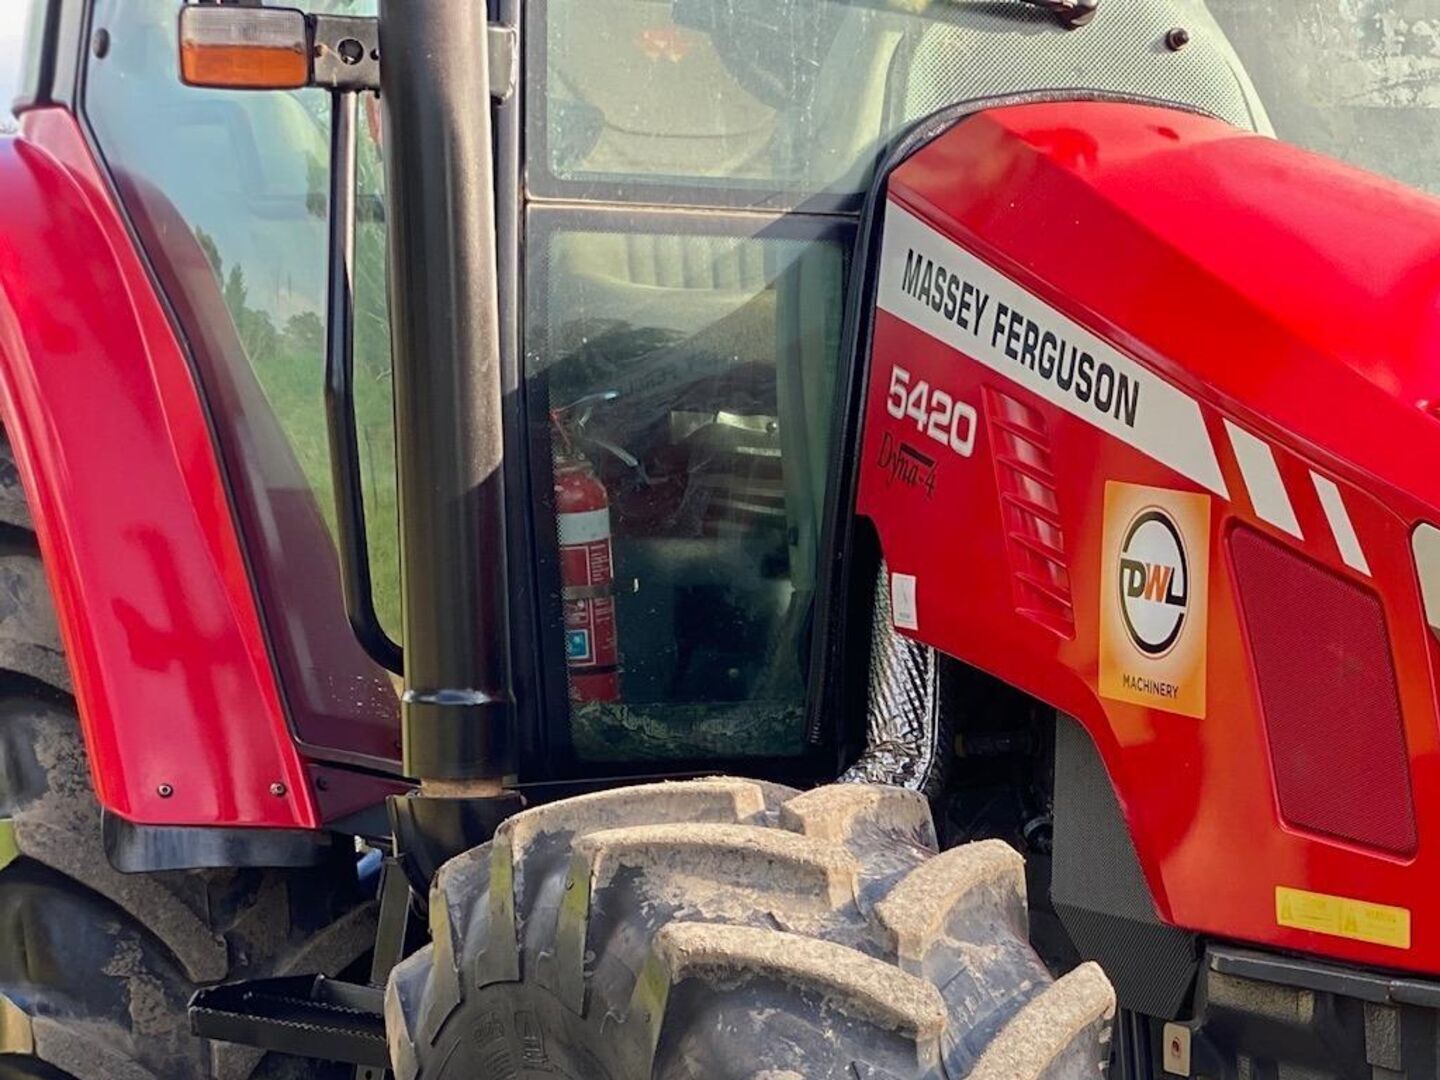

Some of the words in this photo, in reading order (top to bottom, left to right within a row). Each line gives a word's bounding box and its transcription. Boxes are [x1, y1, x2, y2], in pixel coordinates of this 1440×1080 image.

[902, 247, 990, 337] MASSEY
[991, 301, 1140, 428] FERGUSON
[887, 364, 977, 458] 5420
[1122, 672, 1180, 698] MACHINERY
